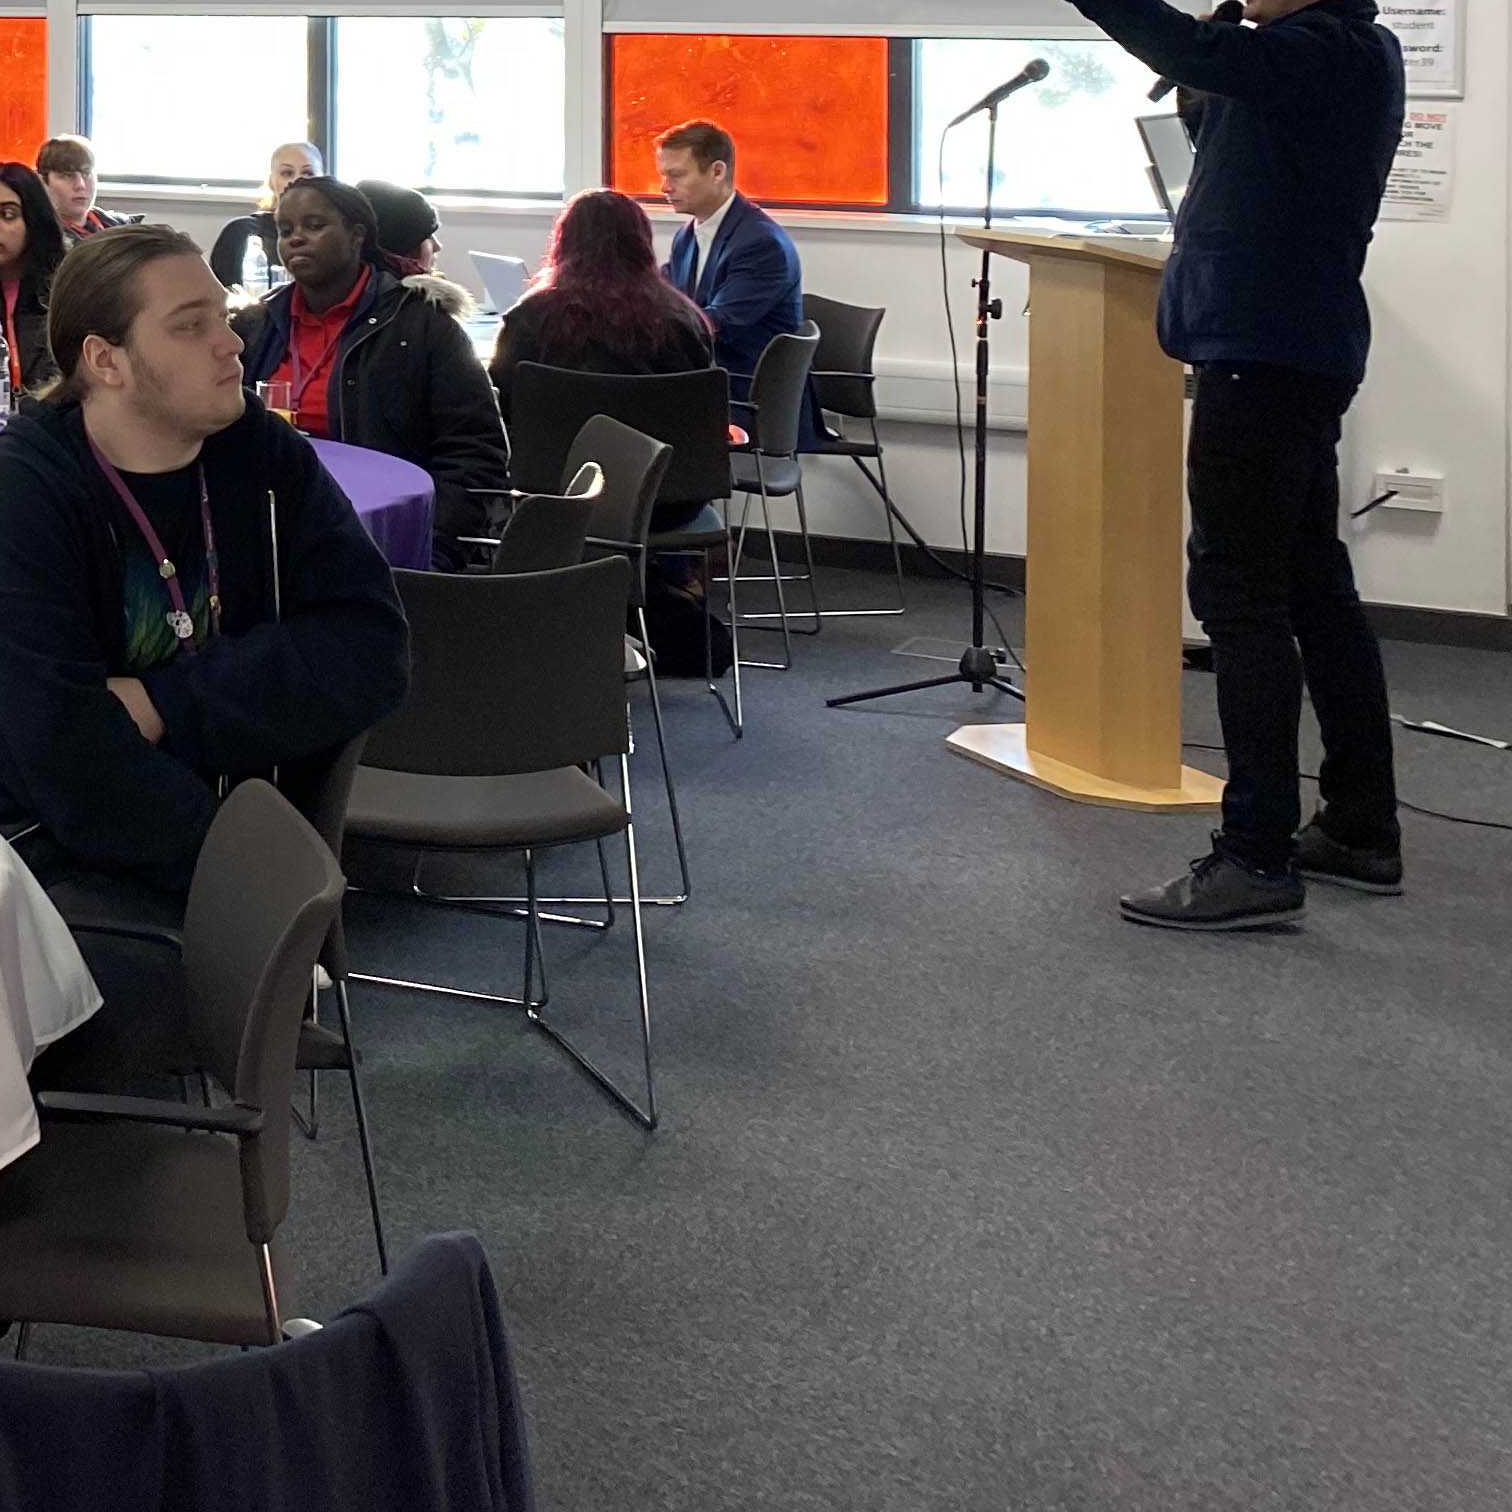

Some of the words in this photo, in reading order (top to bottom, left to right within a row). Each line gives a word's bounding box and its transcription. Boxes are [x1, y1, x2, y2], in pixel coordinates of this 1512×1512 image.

[1382, 6, 1446, 15] Username:
[1392, 20, 1434, 29] student
[1402, 44, 1444, 52] sword:
